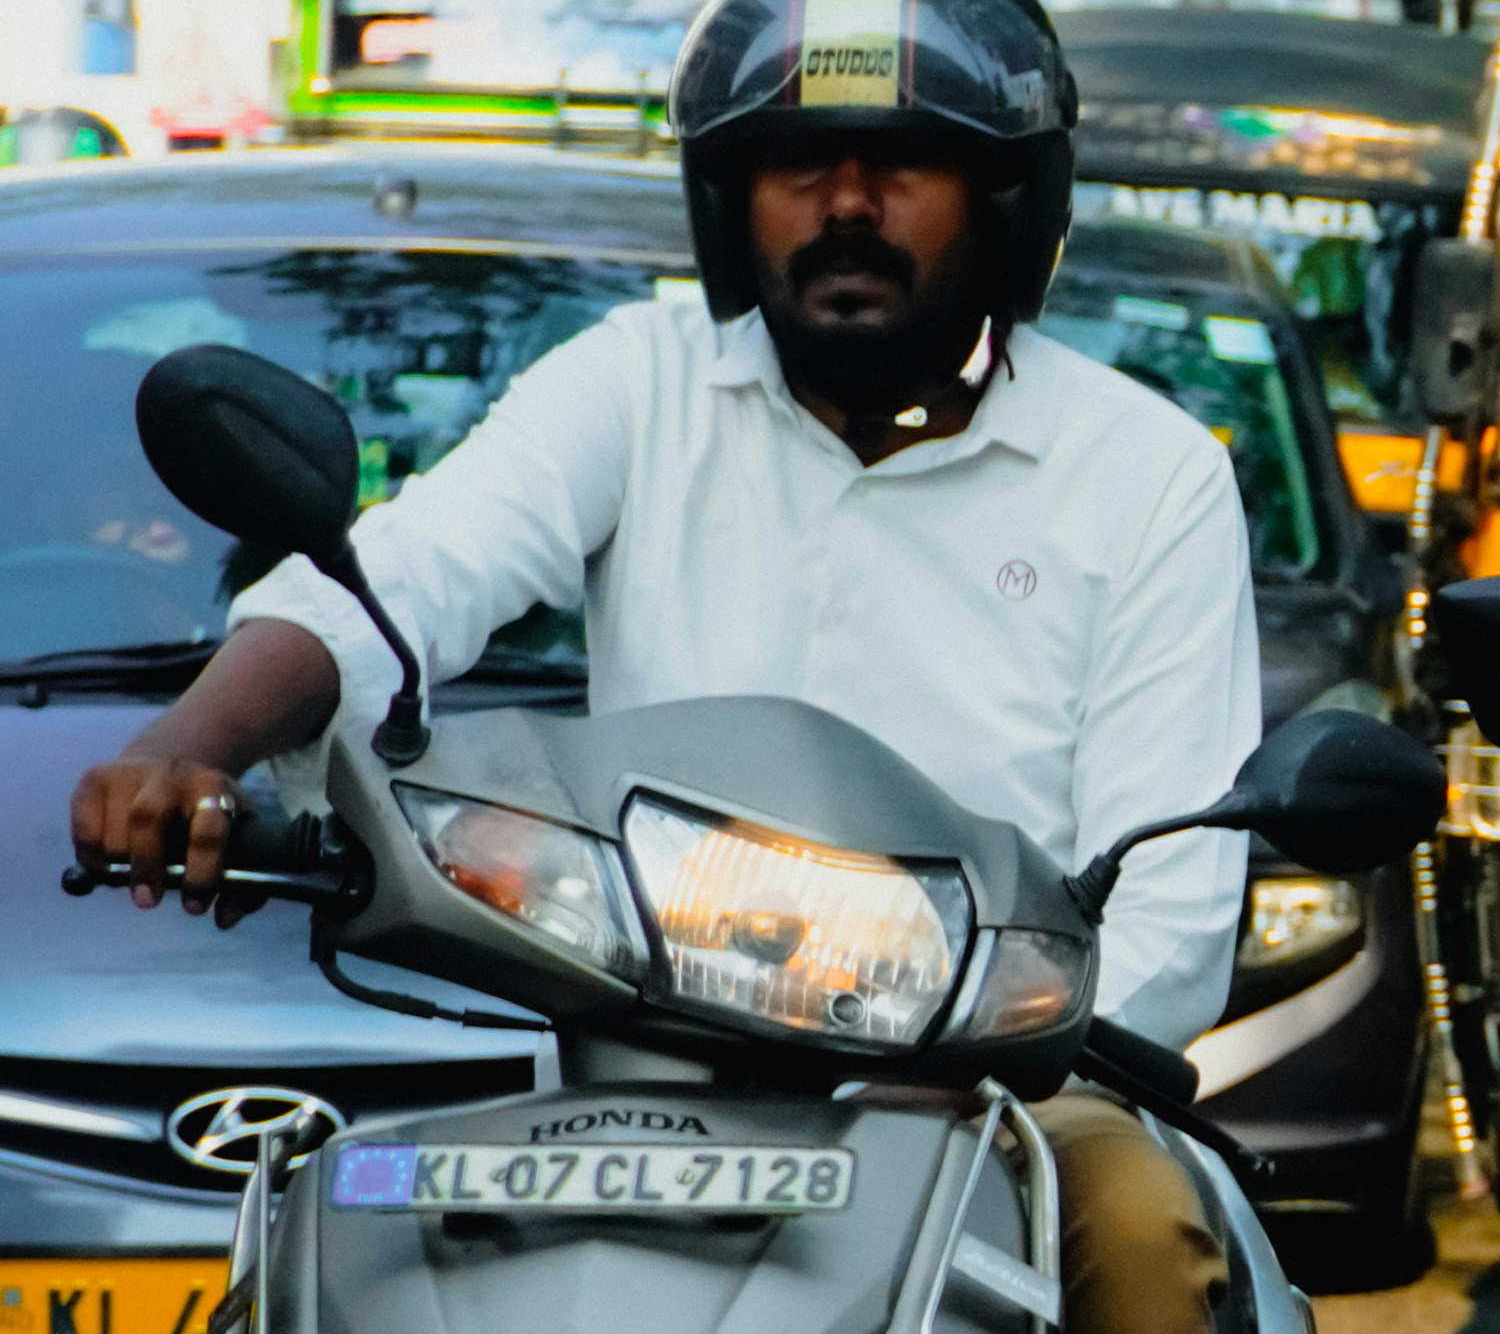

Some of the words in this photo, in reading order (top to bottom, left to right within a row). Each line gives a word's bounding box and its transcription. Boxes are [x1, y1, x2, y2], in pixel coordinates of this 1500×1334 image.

[529, 1110, 713, 1144] HONDA
[412, 1154, 482, 1201] KL
[686, 1154, 841, 1202] 7128
